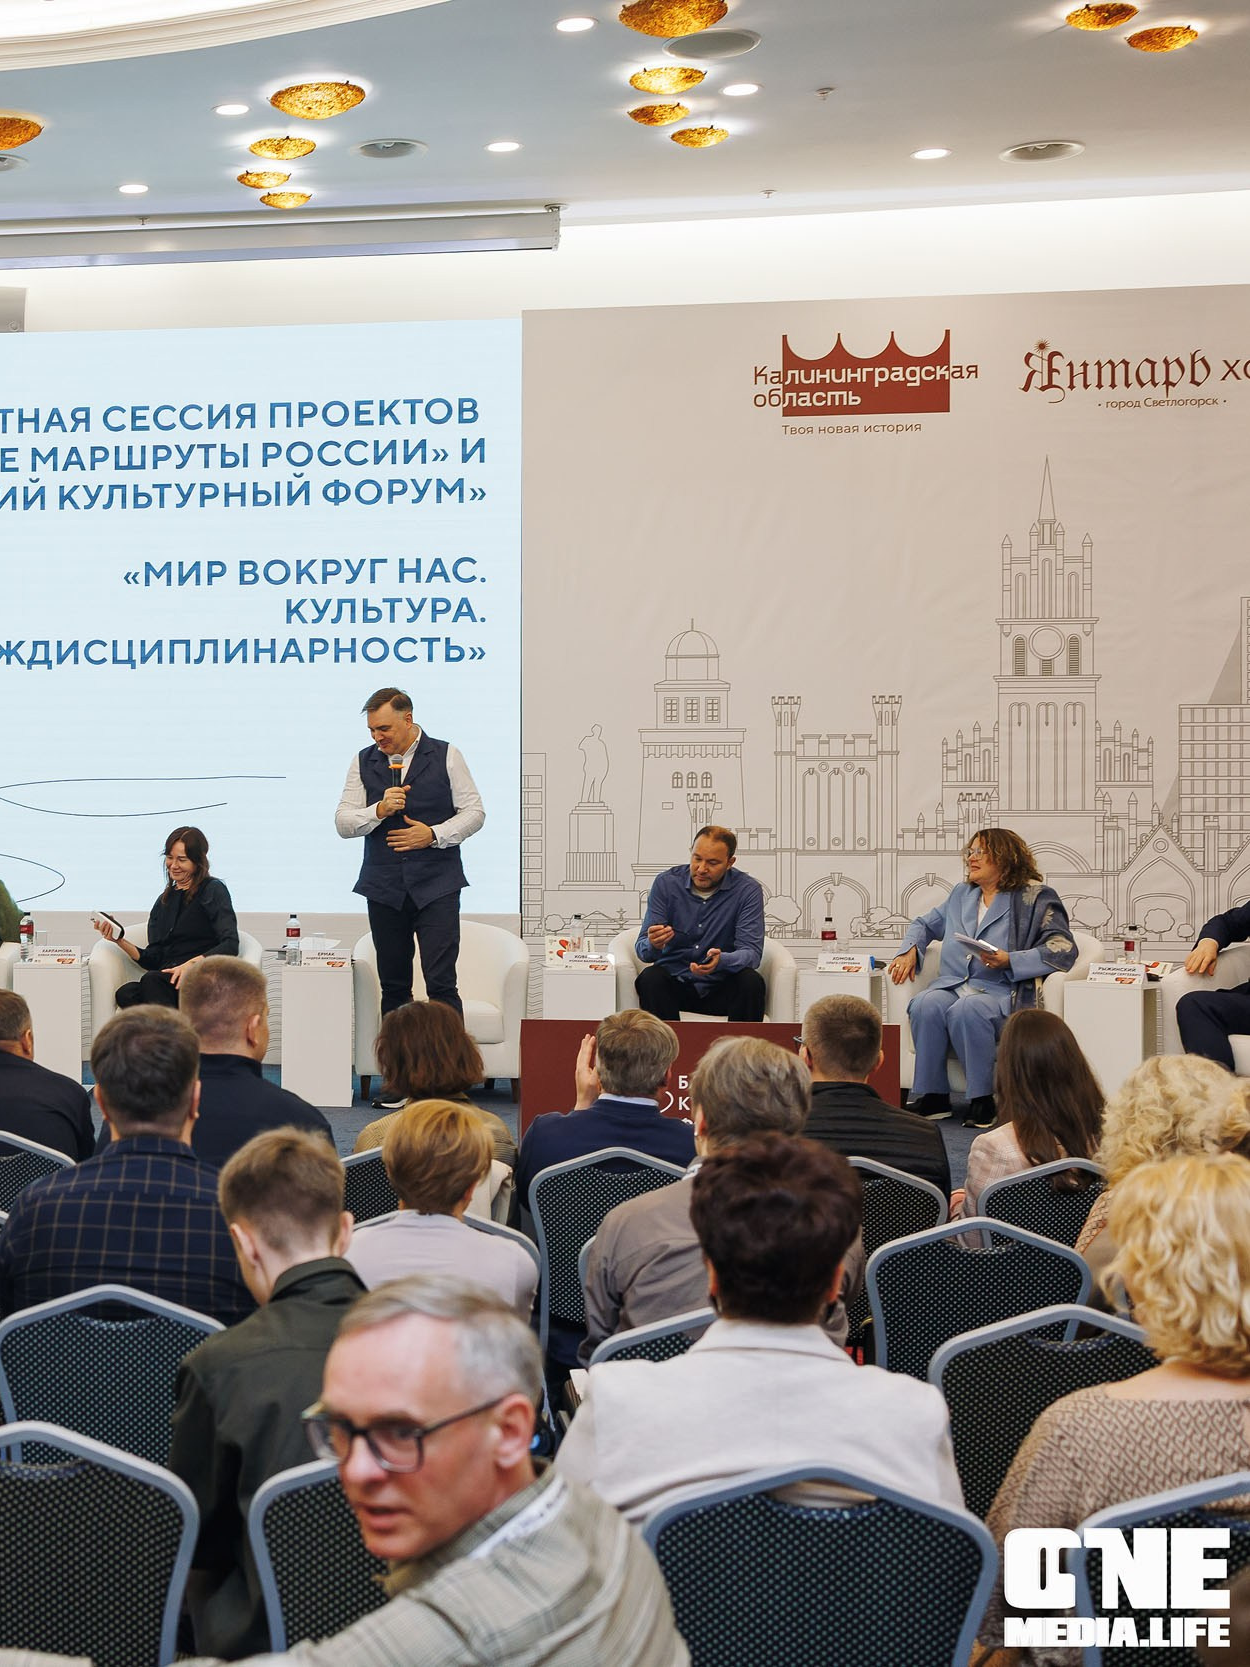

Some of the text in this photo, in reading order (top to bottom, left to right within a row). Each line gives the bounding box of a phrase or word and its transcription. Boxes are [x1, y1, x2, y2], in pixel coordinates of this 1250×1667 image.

[753, 364, 979, 388] Калининградская
[1017, 338, 1212, 404] Янтарь
[753, 387, 862, 408] область
[1105, 396, 1219, 411] город Светлогорск
[102, 402, 256, 432] СЕССИЯ
[269, 397, 479, 429] ПРОЕКТОВ
[782, 422, 922, 436] Твоя новая история
[31, 442, 249, 473] МАРШРУТЫ
[261, 439, 450, 468] РОССИИ»
[461, 437, 486, 464] И
[58, 472, 310, 511] КУЛЬТУРНЫЙ
[321, 477, 487, 506] ФОРУМ»
[123, 556, 487, 587] «МИР ВОКРУГ НАС.
[285, 596, 487, 625] КУЛЬТУРА.
